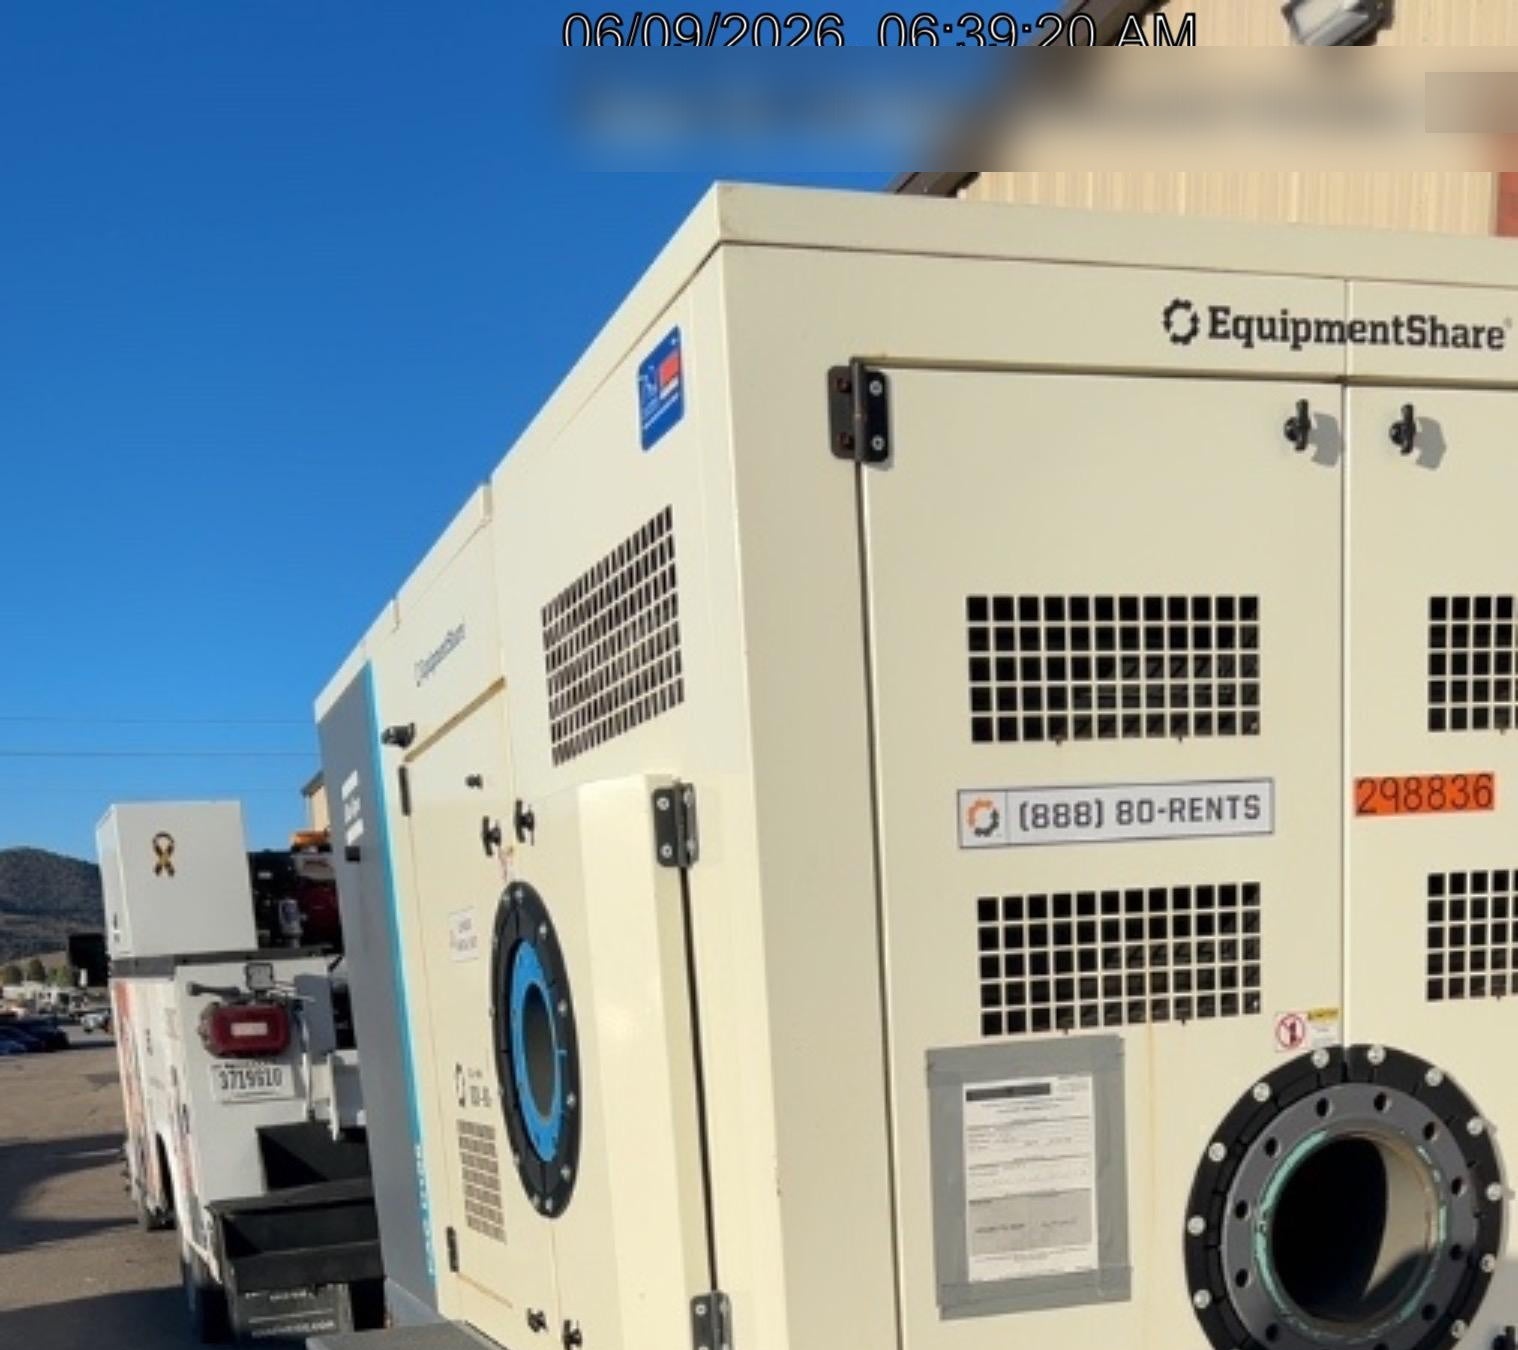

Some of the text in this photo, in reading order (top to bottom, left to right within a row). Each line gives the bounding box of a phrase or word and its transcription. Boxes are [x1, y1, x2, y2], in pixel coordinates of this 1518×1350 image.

[1208, 305, 1506, 351] EquipmentShare
[1019, 793, 1262, 831] (888) 80-RENTS
[1357, 773, 1494, 814] 298836
